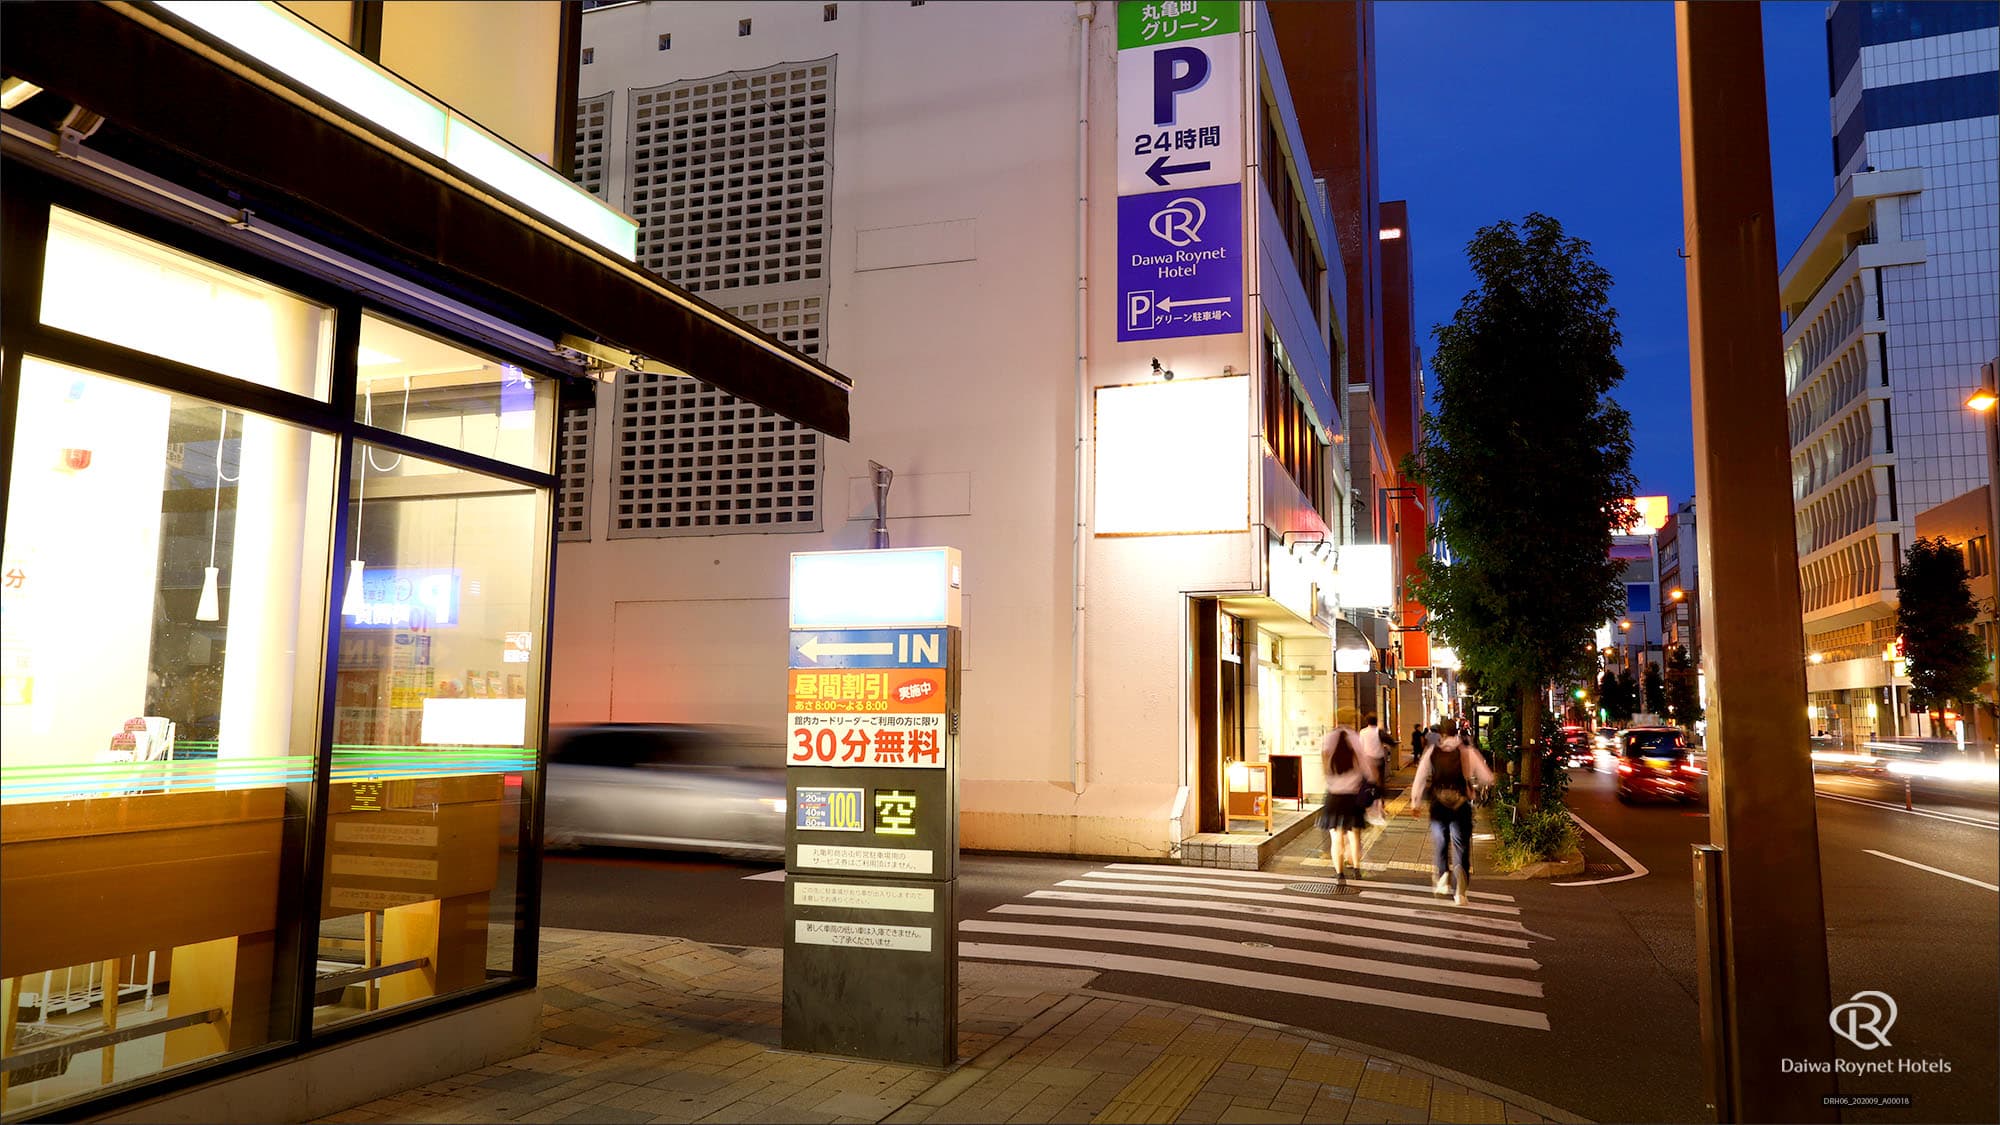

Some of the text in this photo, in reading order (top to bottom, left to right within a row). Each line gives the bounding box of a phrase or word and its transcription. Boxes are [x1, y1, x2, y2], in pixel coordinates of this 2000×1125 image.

[1142, 0, 1198, 21] 丸亀町
[1141, 16, 1218, 41] グリーン
[1154, 46, 1211, 127] P
[1134, 126, 1220, 155] 24時間
[1132, 247, 1227, 267] Daiwa Roynet
[1158, 264, 1197, 279] Hotel
[1131, 295, 1151, 327] P
[898, 634, 939, 664] IN
[795, 673, 889, 700] 昼間割引
[898, 681, 932, 701] 実施中
[792, 727, 940, 764] 30分無料
[875, 790, 916, 835] 空
